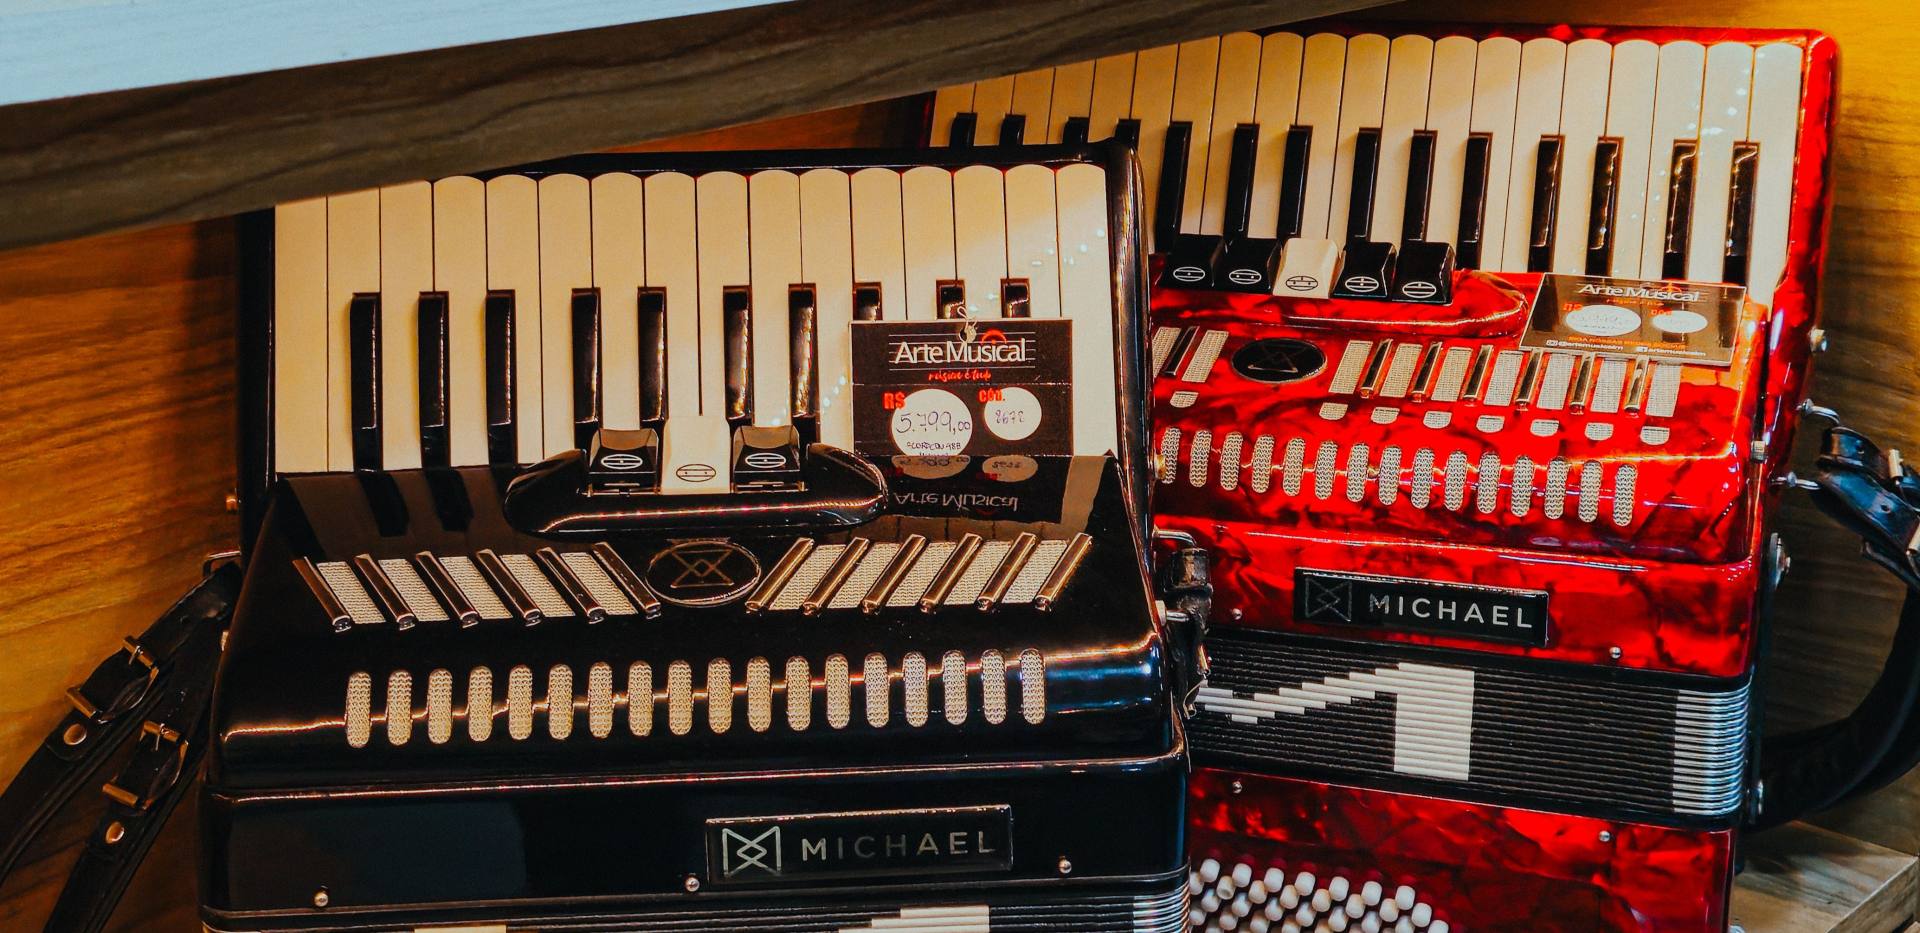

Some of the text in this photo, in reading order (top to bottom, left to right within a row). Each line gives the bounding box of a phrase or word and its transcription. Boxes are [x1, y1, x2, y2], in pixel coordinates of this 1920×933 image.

[1578, 283, 1699, 302] Arte Musical
[894, 337, 1026, 364] Arte Musical
[1369, 592, 1533, 628] MICHAEL
[801, 830, 998, 861] MICHAEL
